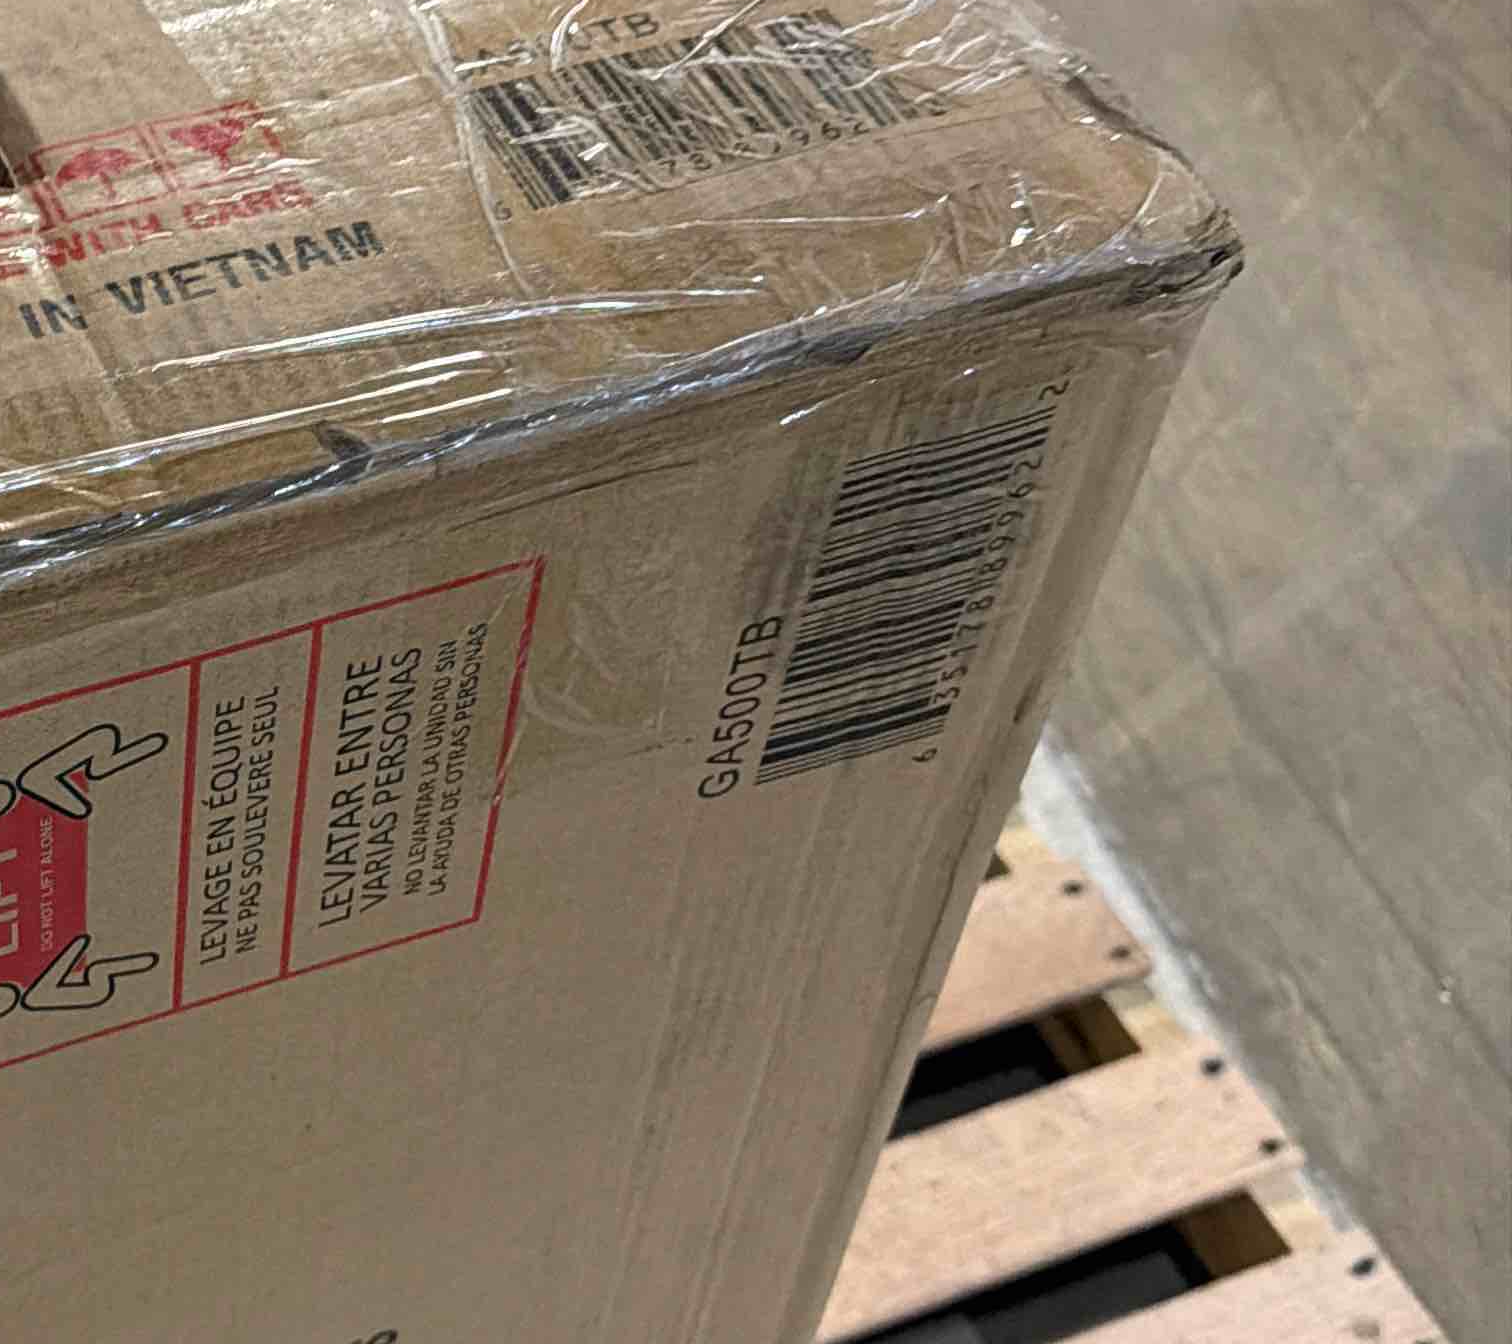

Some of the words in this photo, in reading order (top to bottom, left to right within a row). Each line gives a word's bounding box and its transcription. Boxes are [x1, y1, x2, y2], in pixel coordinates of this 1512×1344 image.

[18, 294, 87, 339] IN
[103, 221, 386, 317] VIETNAM
[912, 747, 938, 764] 6
[1038, 380, 1070, 401] 2
[434, 639, 458, 673] SIN
[452, 622, 489, 723] PERSONAS
[250, 685, 281, 748] SEUL
[333, 655, 383, 777] ENTRE
[371, 647, 422, 808] PERSONAS
[423, 676, 453, 751] UNIDAD
[697, 615, 784, 799] GA500TB
[200, 695, 246, 811] ÉQUIPE
[420, 750, 441, 777] LA
[444, 724, 472, 785] OTRAS
[240, 749, 274, 880] SOULEVERE
[407, 778, 437, 867] LEVANTAR
[439, 786, 462, 813] DE
[39, 814, 57, 865] ALONE
[205, 815, 237, 857] EN
[317, 781, 367, 929] LEVATAR
[359, 811, 399, 915] VARIAS
[431, 812, 459, 871] AYUDA
[39, 869, 55, 899] LIFT
[39, 898, 57, 929] NOT
[199, 859, 233, 966] LEVAGE
[237, 880, 263, 923] PAS
[402, 868, 424, 896] NO
[427, 873, 448, 897] LA
[234, 923, 259, 955] NE
